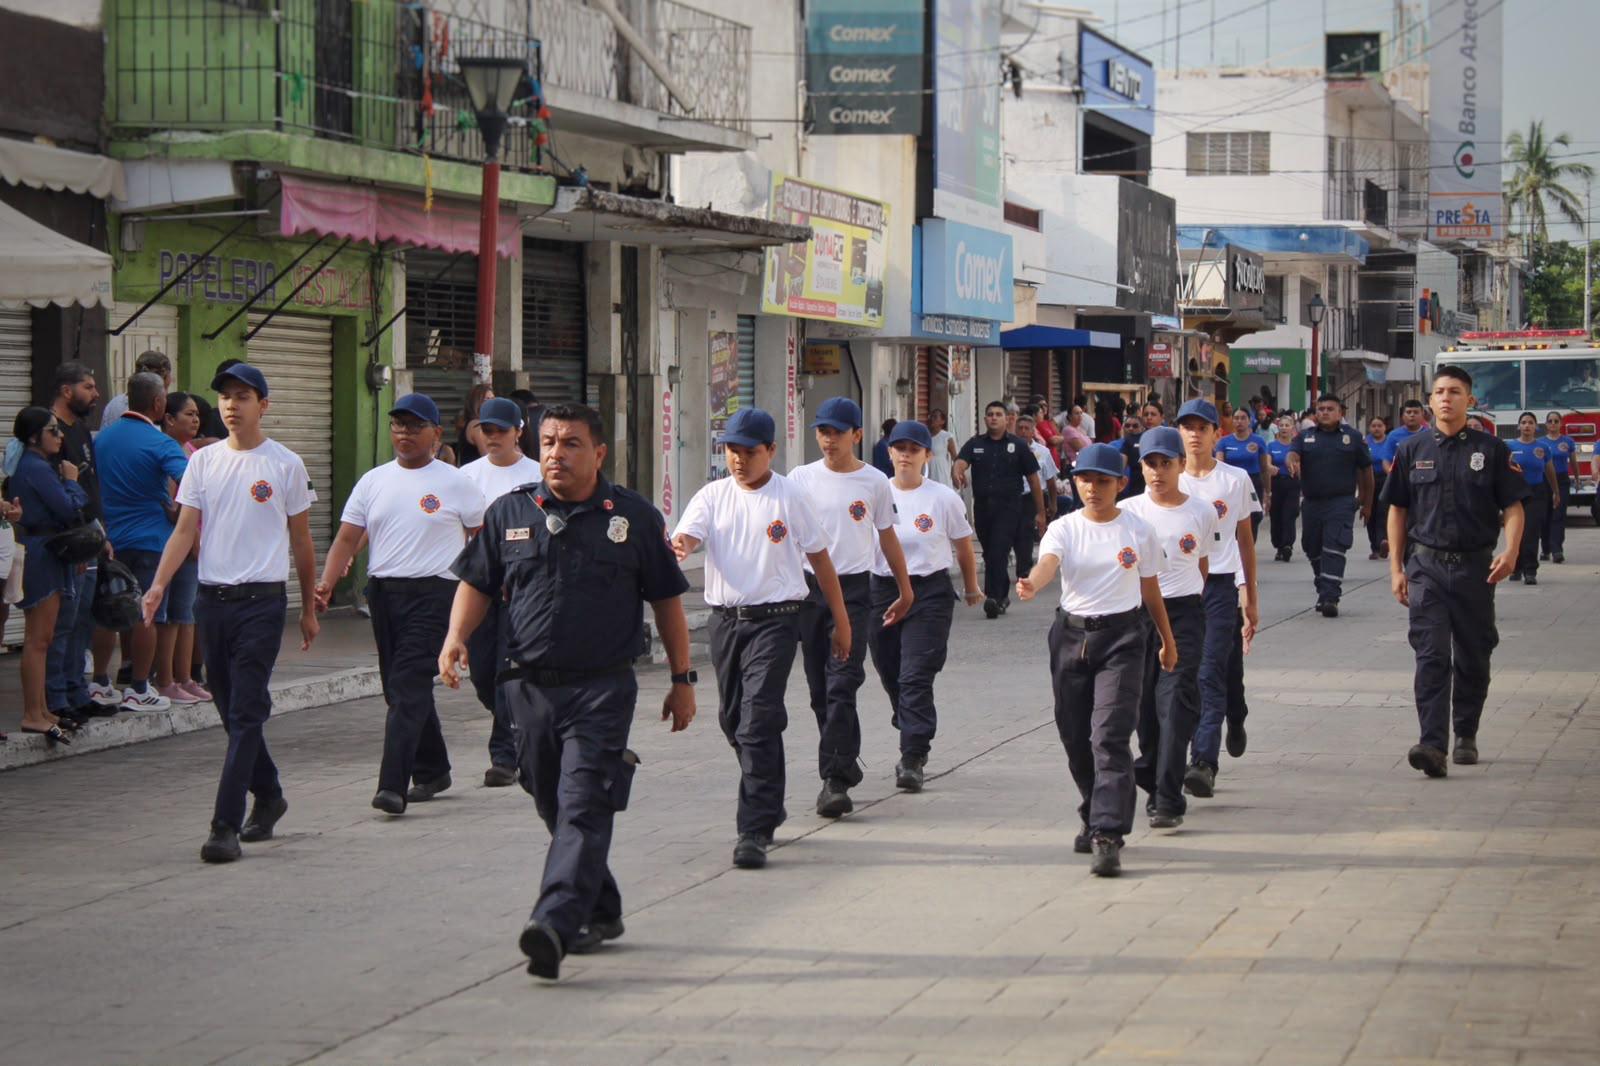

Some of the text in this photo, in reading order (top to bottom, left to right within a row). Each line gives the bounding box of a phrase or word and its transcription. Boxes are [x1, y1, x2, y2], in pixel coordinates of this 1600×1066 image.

[830, 25, 896, 41] Comex
[830, 66, 896, 82] Comex
[1459, 66, 1476, 136] Banco
[829, 107, 896, 123] Comex
[955, 240, 1006, 304] Comex
[787, 320, 795, 448] INTERNET
[663, 391, 672, 516] COPIAS
